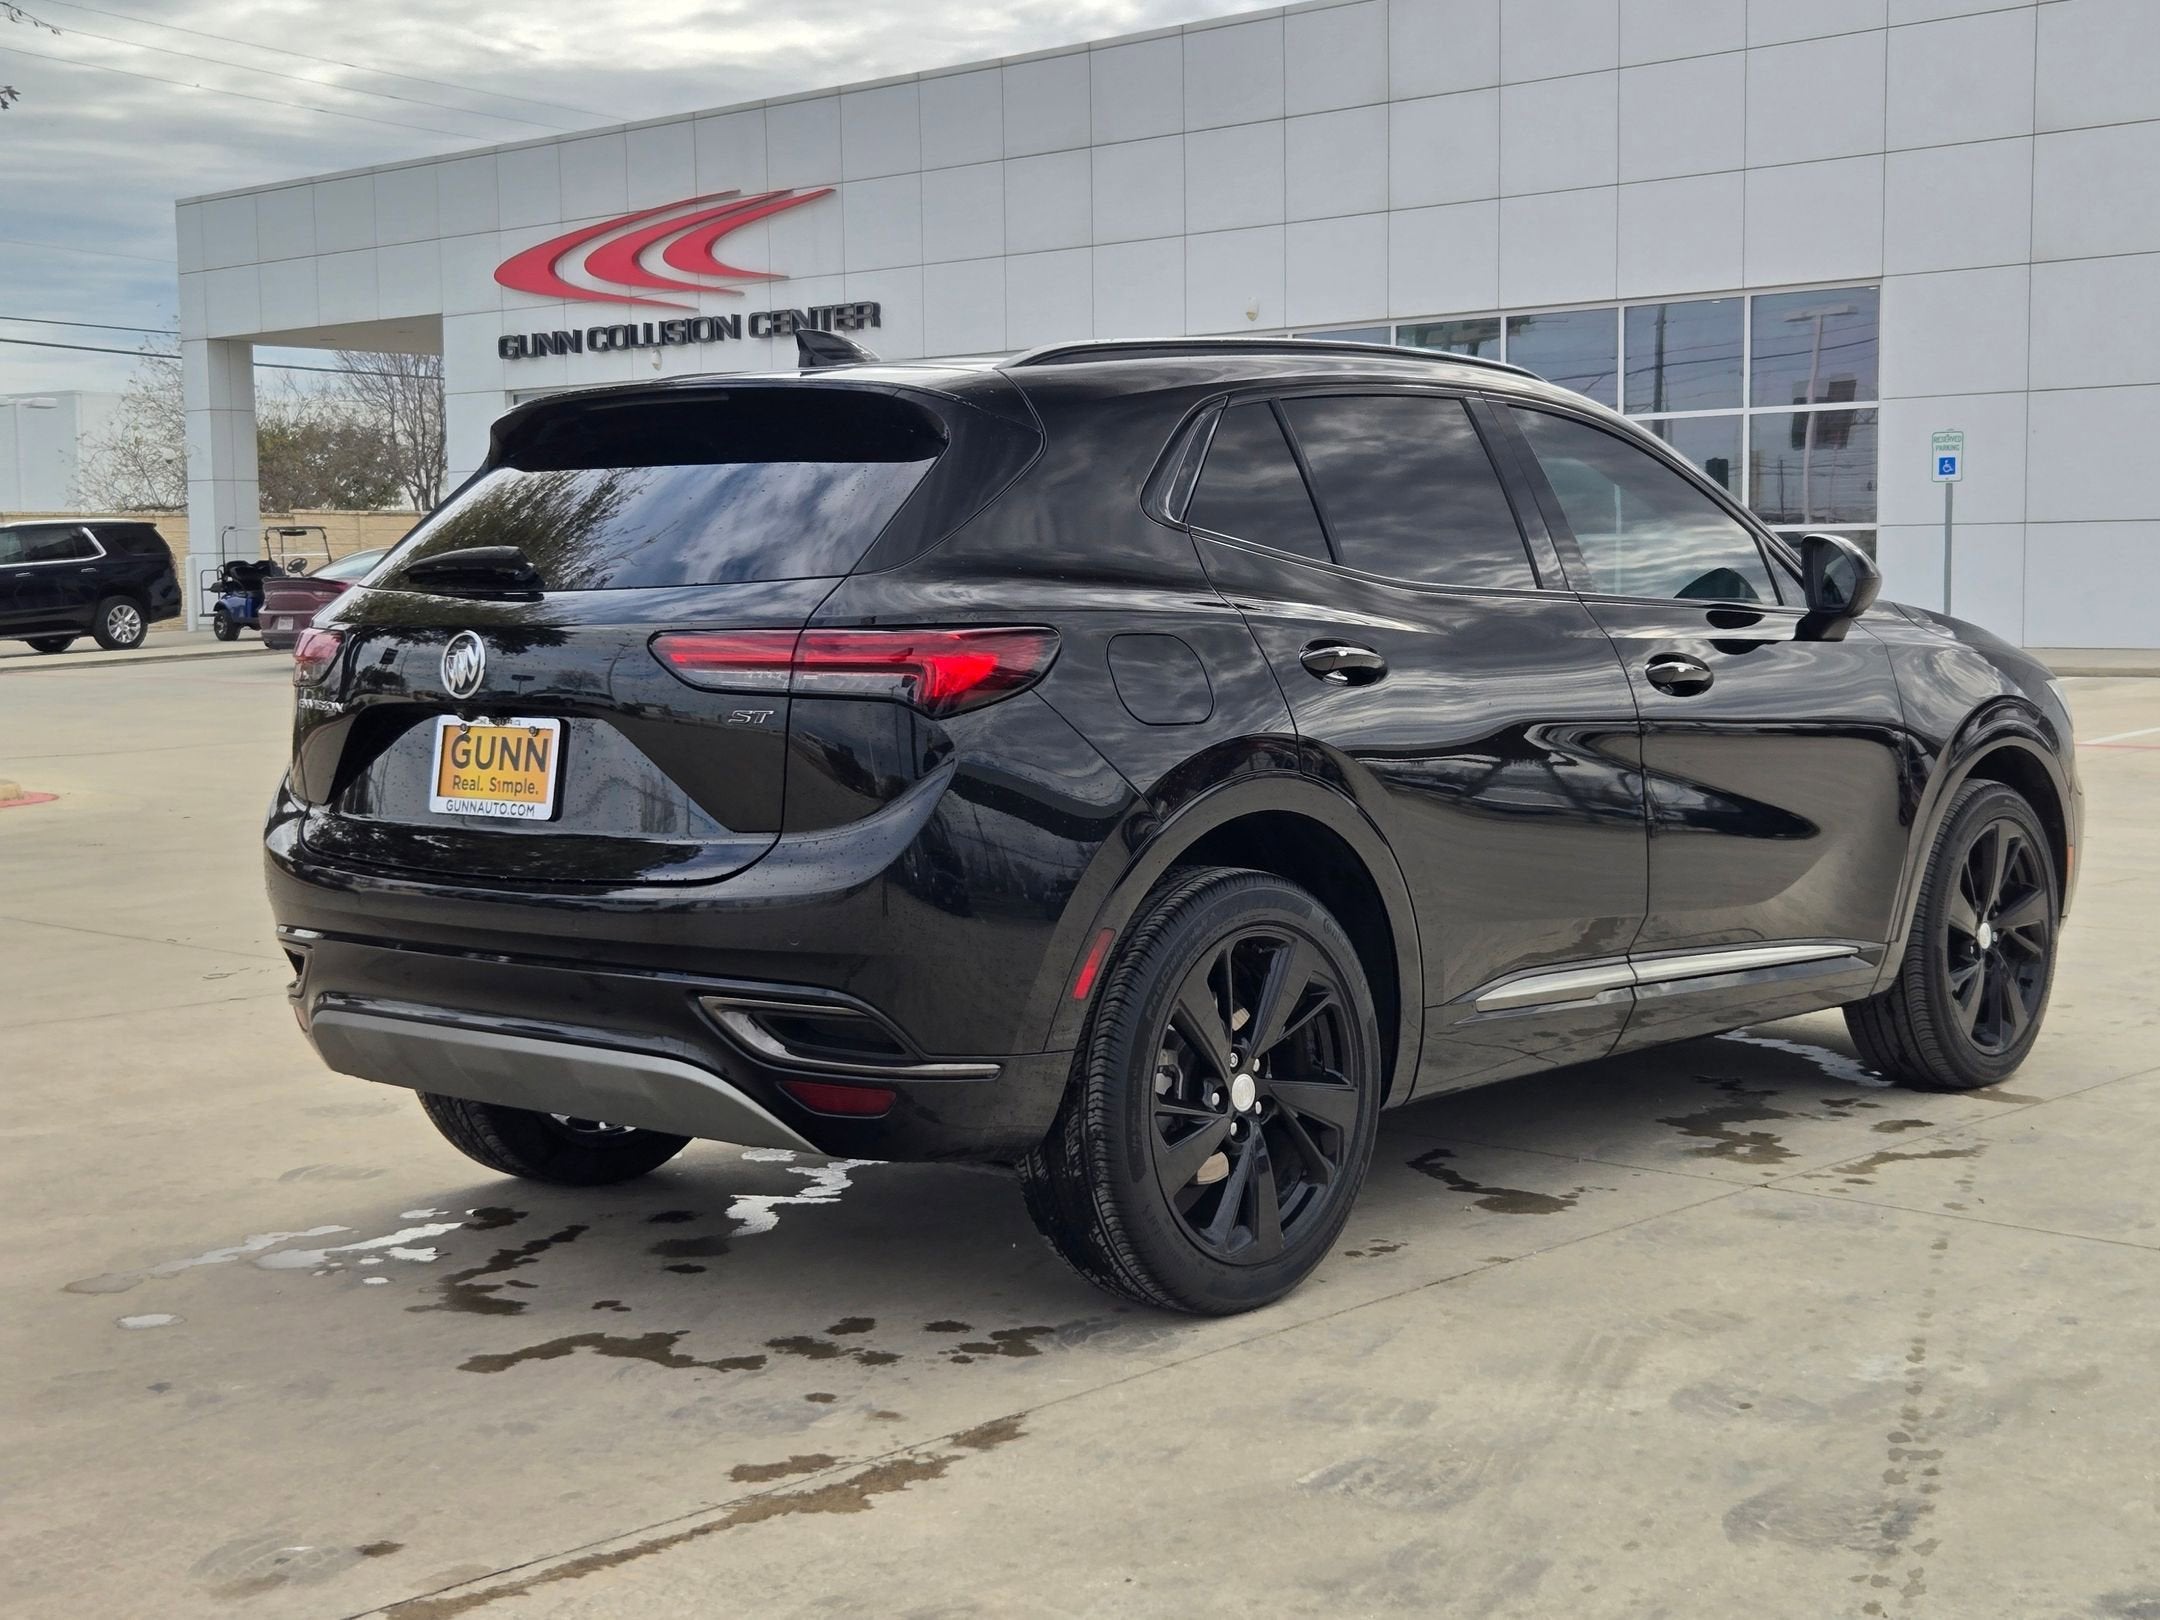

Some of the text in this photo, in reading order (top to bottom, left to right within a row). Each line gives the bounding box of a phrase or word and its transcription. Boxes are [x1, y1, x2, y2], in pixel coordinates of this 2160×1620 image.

[498, 301, 881, 360] GUNN COLLISION CENTER
[728, 709, 774, 724] ST
[451, 734, 549, 772] GUNN
[452, 775, 484, 791] Real.
[446, 800, 535, 817] GUNNAUTO.COM
